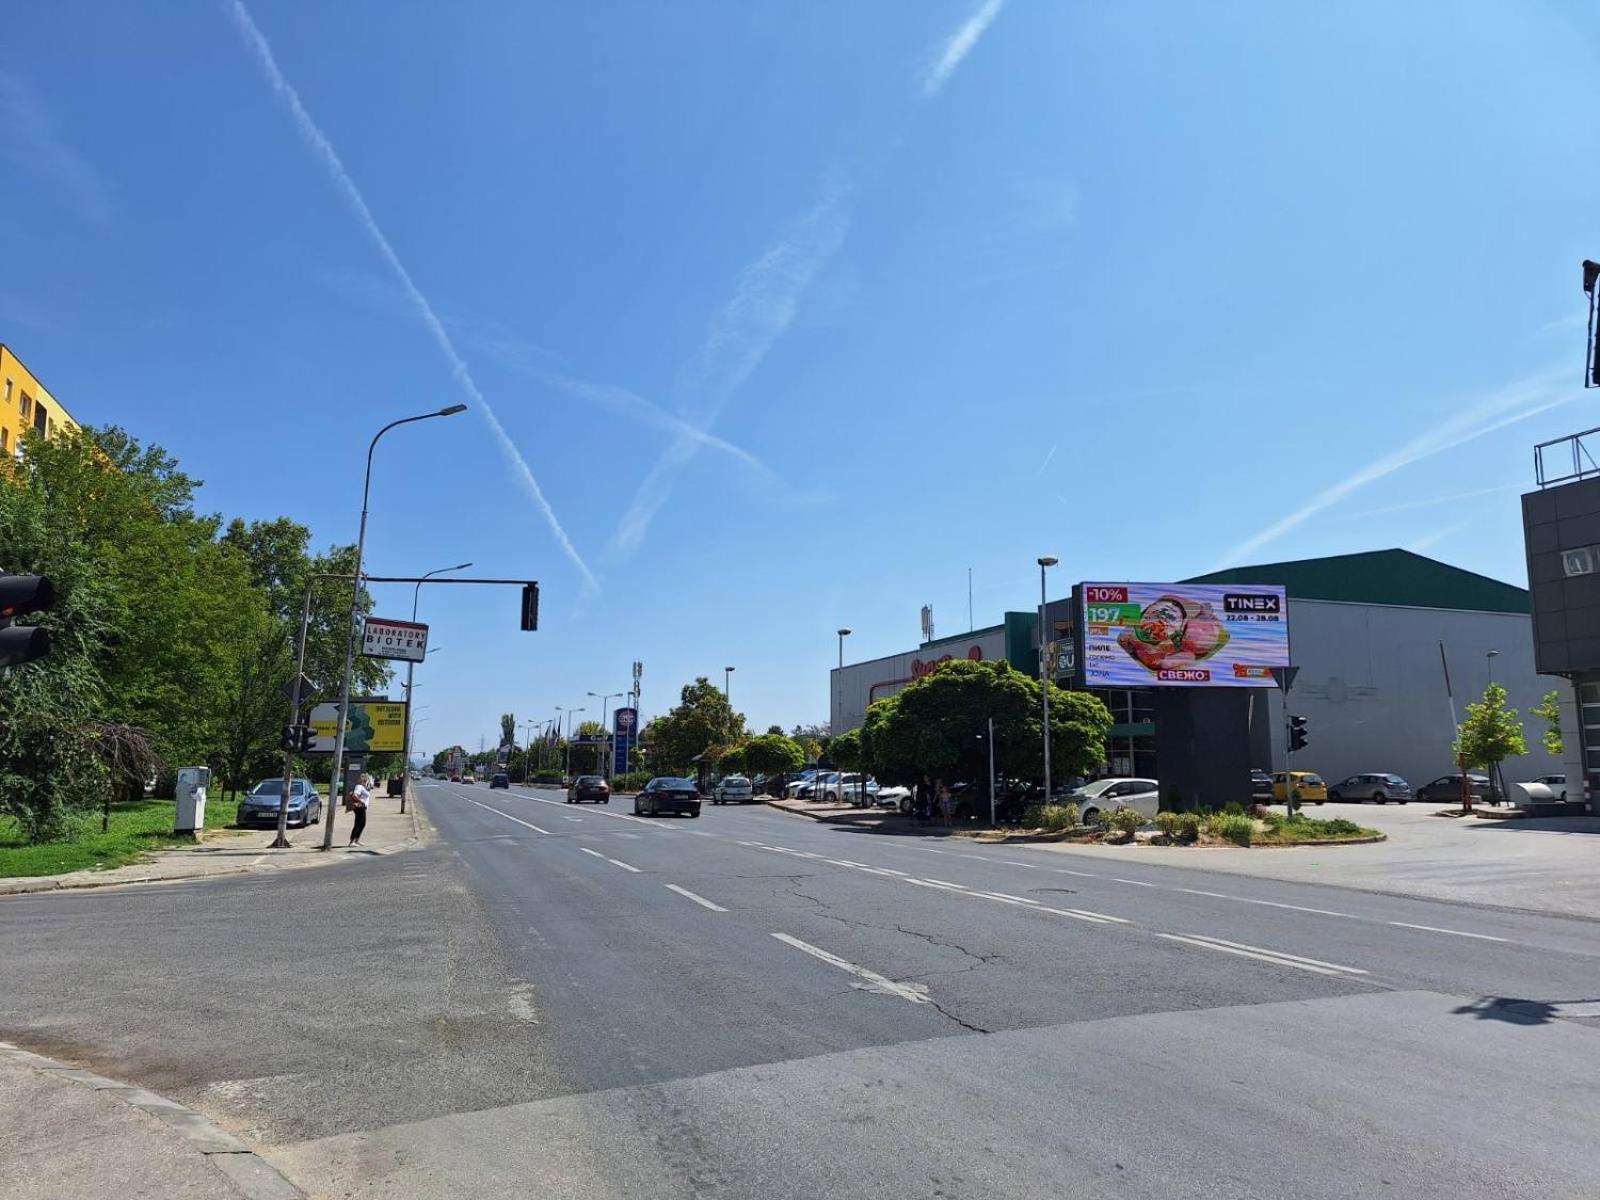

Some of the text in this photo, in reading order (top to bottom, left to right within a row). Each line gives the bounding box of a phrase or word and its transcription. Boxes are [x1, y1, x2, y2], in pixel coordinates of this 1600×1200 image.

[1088, 588, 1122, 601] -10%
[1227, 597, 1276, 609] TINEX
[367, 626, 426, 639] LABORATORY
[366, 634, 424, 649] BIOTEK
